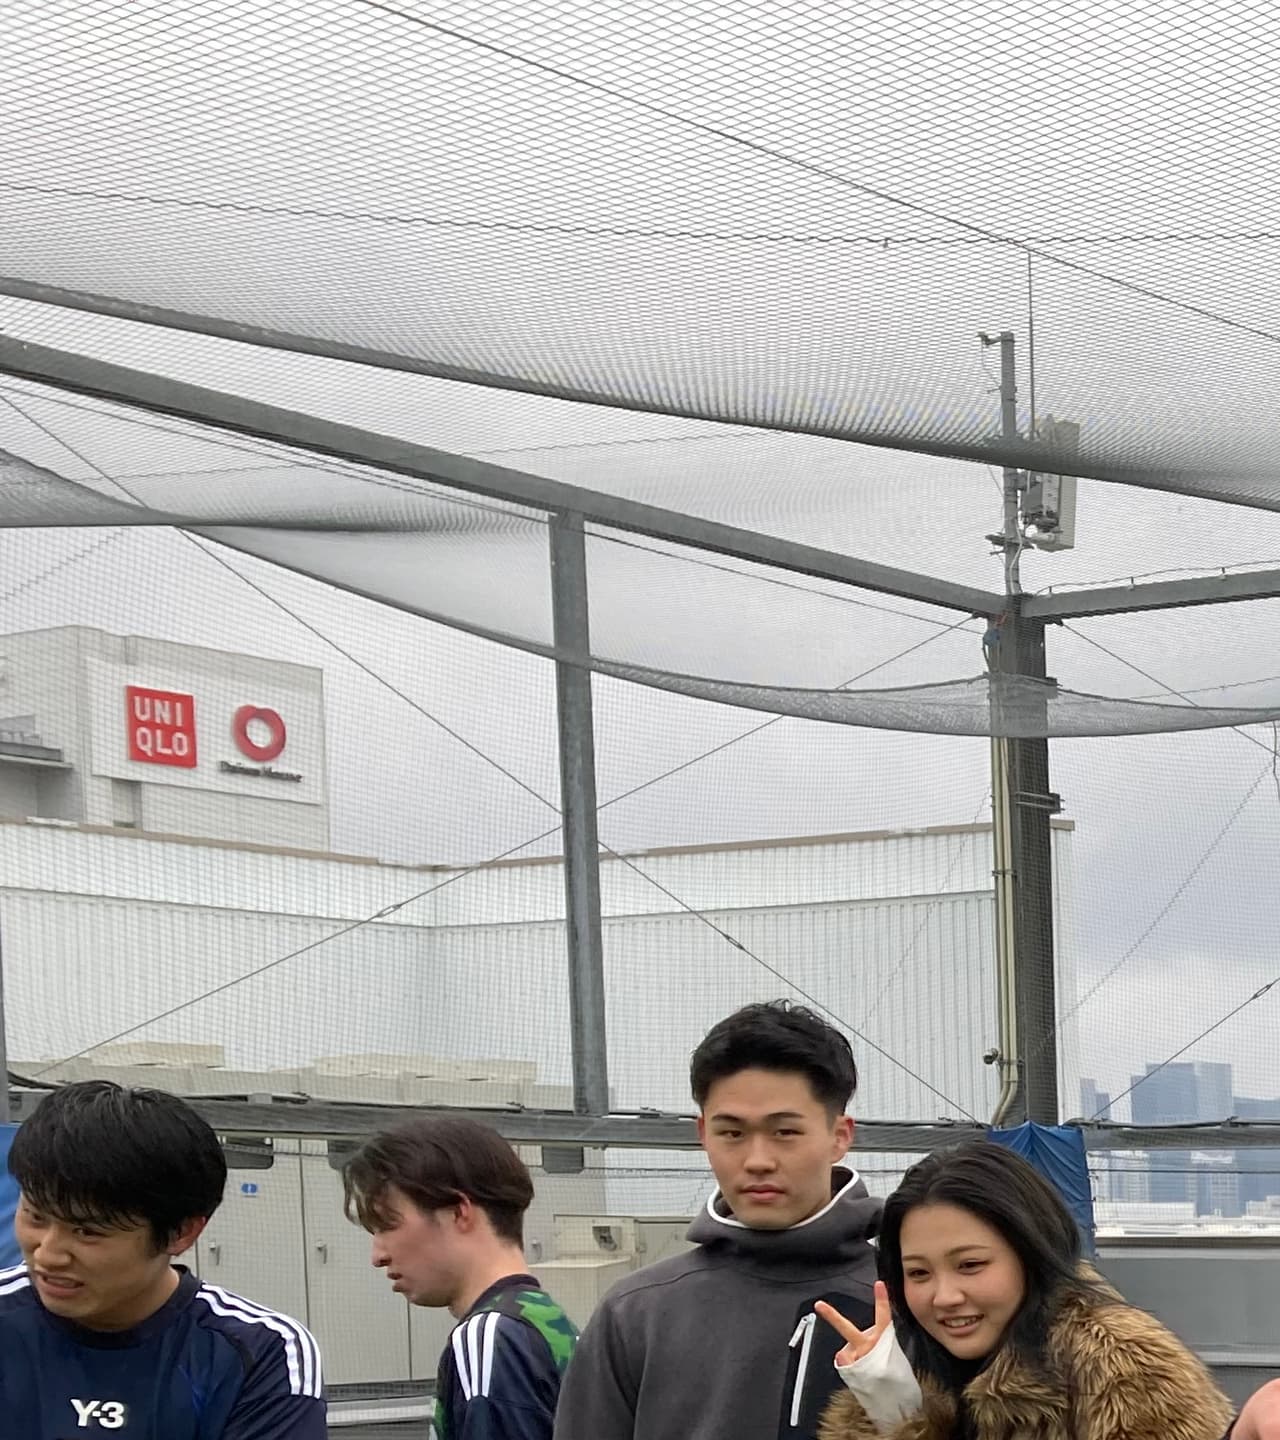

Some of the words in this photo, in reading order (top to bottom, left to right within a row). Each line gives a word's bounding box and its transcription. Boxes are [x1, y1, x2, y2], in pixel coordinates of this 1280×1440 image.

[134, 696, 184, 727] UNI
[136, 727, 188, 757] QLO
[70, 1398, 125, 1429] Y-3
